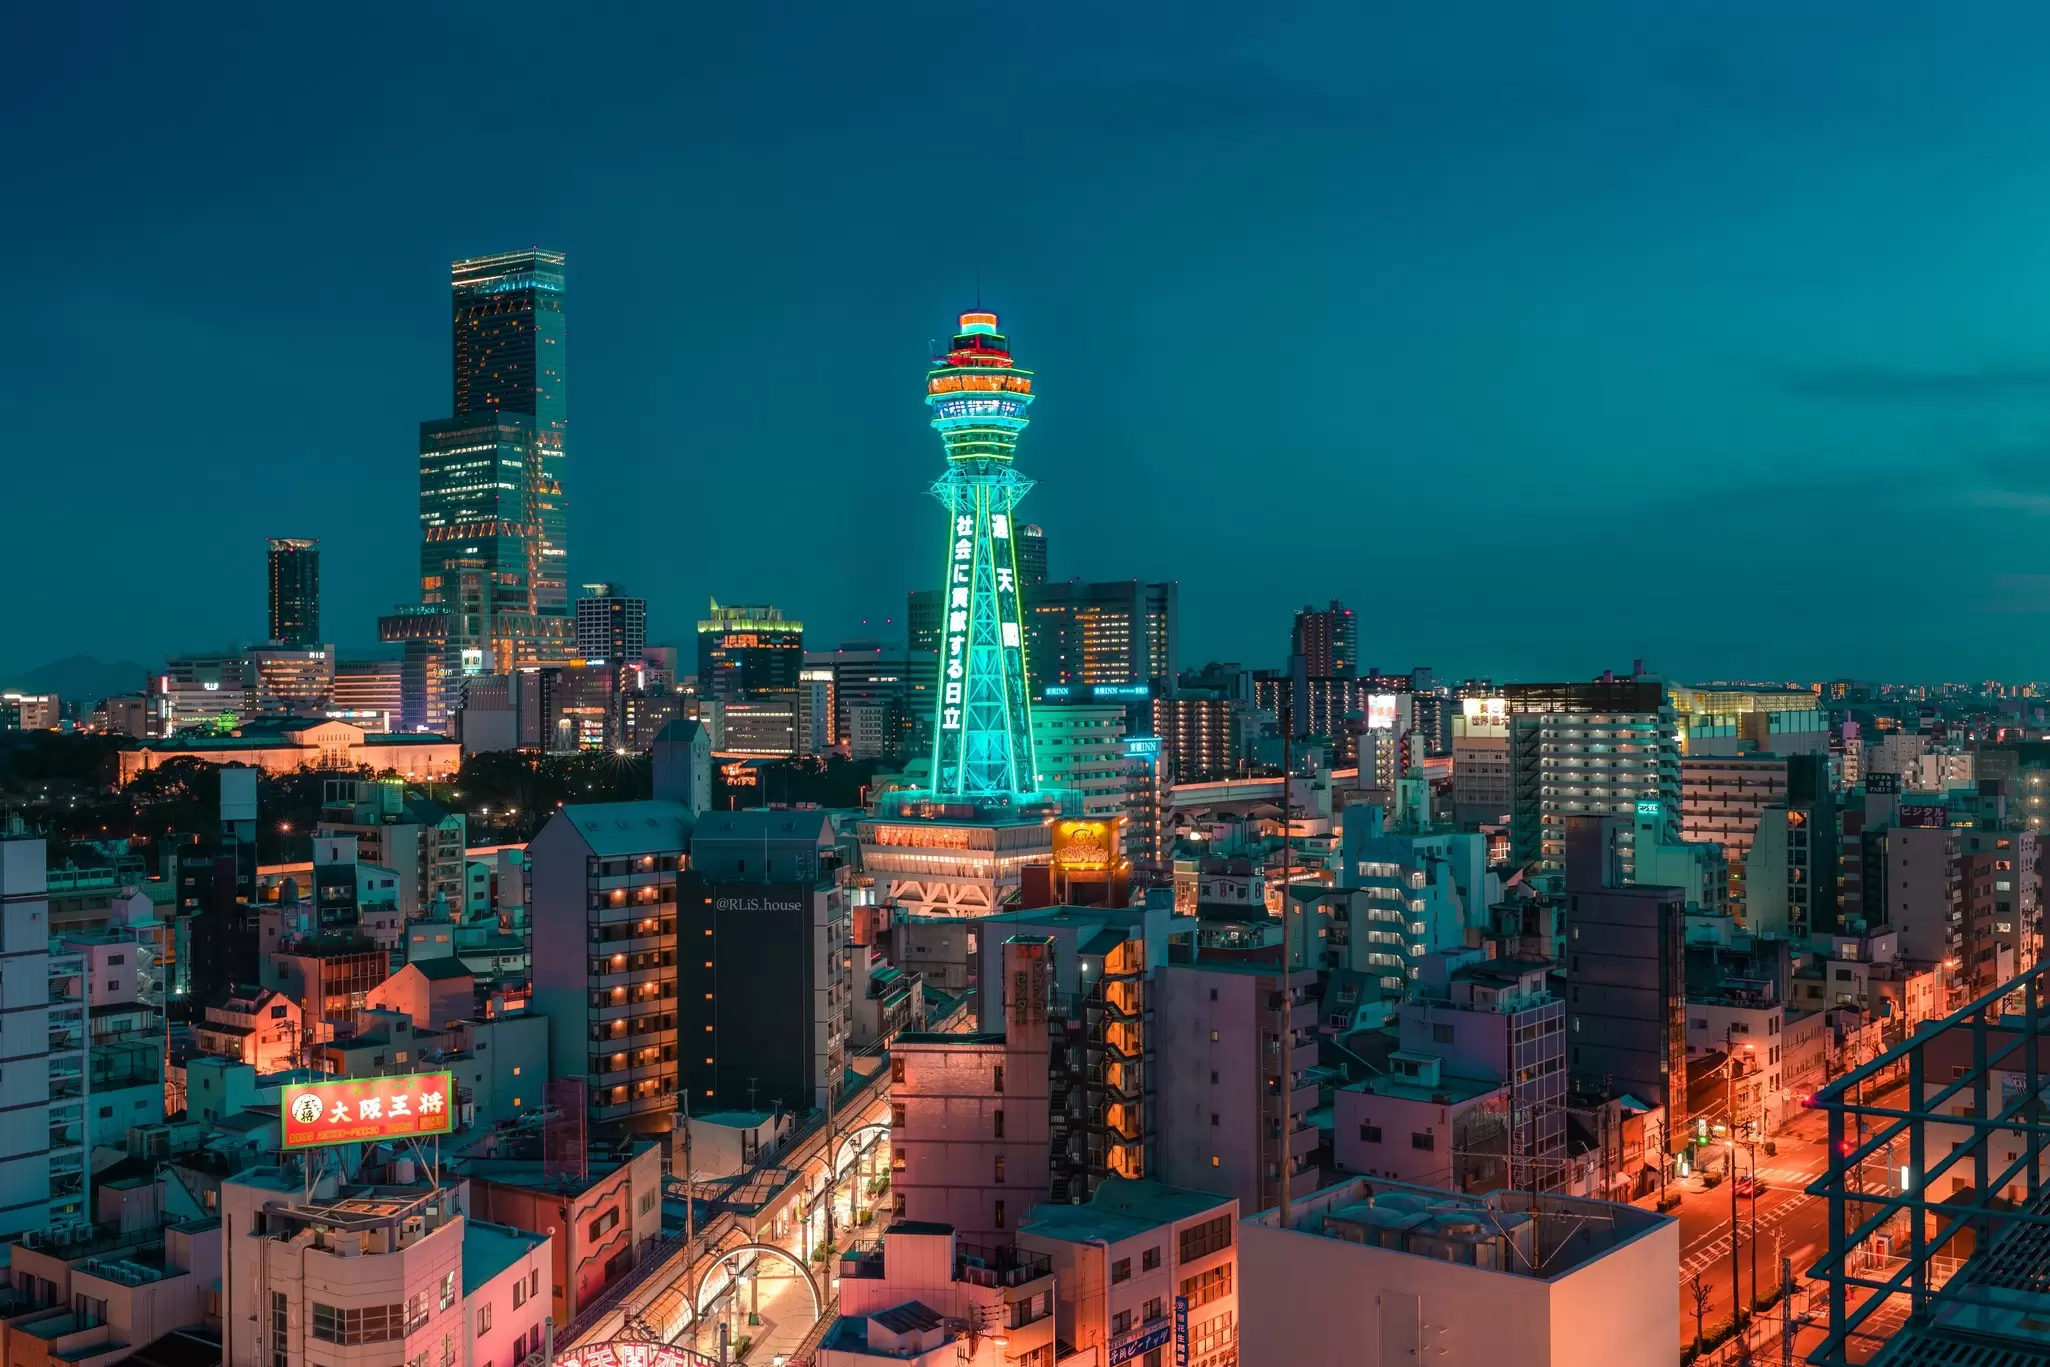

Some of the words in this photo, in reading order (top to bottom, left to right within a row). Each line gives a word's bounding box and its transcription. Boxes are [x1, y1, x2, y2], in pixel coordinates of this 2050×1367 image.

[942, 514, 974, 730] 社会に貢献する日立
[1130, 742, 1157, 753] 東横INN
[300, 1101, 314, 1122] 王将
[327, 1090, 445, 1124] 大阪王将
